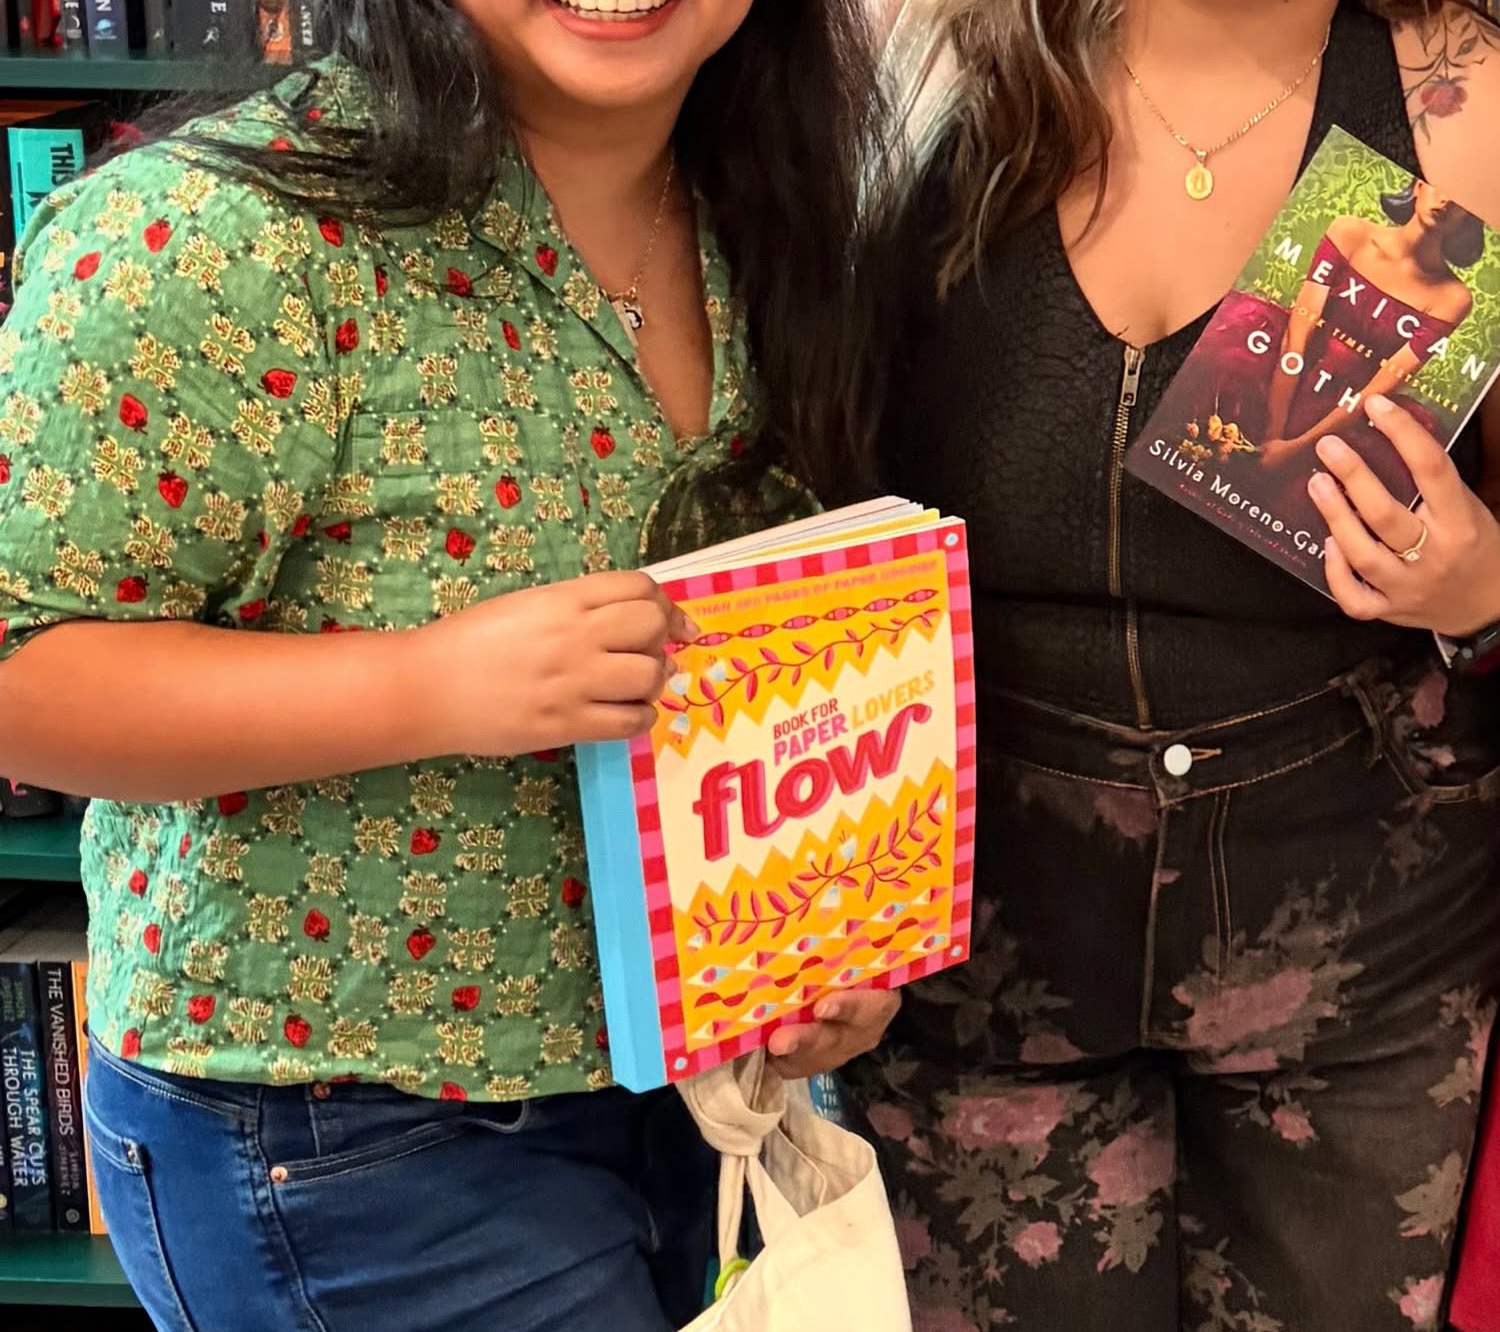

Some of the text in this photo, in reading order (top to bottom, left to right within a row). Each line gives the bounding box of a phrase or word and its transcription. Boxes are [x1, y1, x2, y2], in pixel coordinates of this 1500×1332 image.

[1246, 330, 1361, 412] GOTH
[1275, 237, 1486, 384] MEXICAN
[1148, 439, 1205, 481] Silvia
[1210, 475, 1327, 560] Moreno-Gar
[773, 671, 934, 765] PAPER LOVERS
[773, 698, 838, 739] BOOK FOR
[693, 704, 932, 862] flow
[48, 969, 75, 1136] THE VANISHED BIRDS
